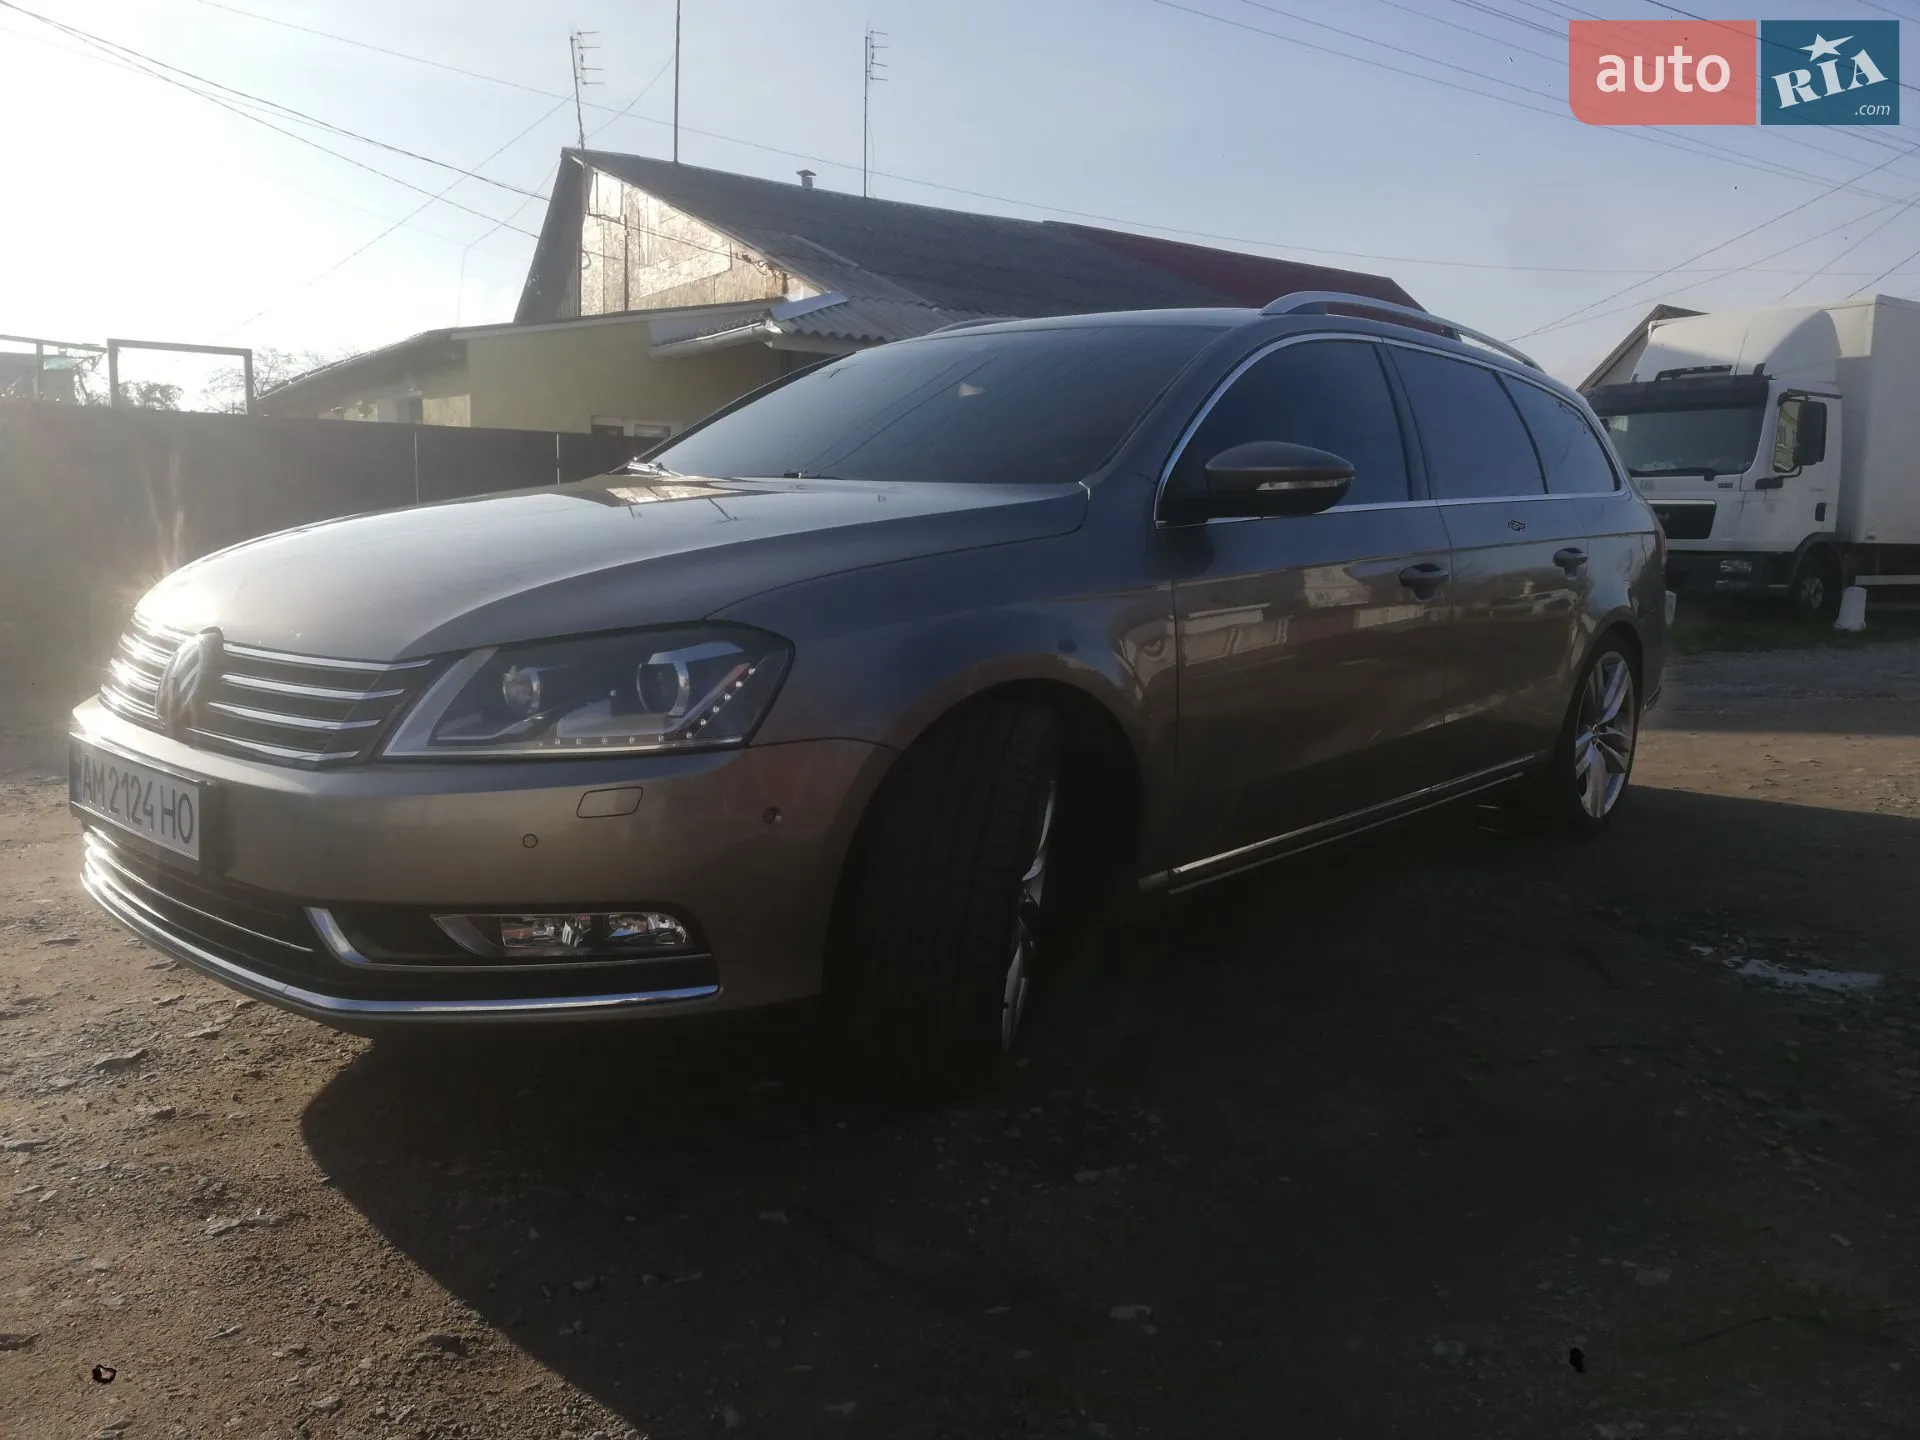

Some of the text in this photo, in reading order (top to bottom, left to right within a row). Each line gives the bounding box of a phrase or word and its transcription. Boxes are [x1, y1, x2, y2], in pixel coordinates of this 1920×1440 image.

[83, 753, 194, 844] AM 2124 HO
